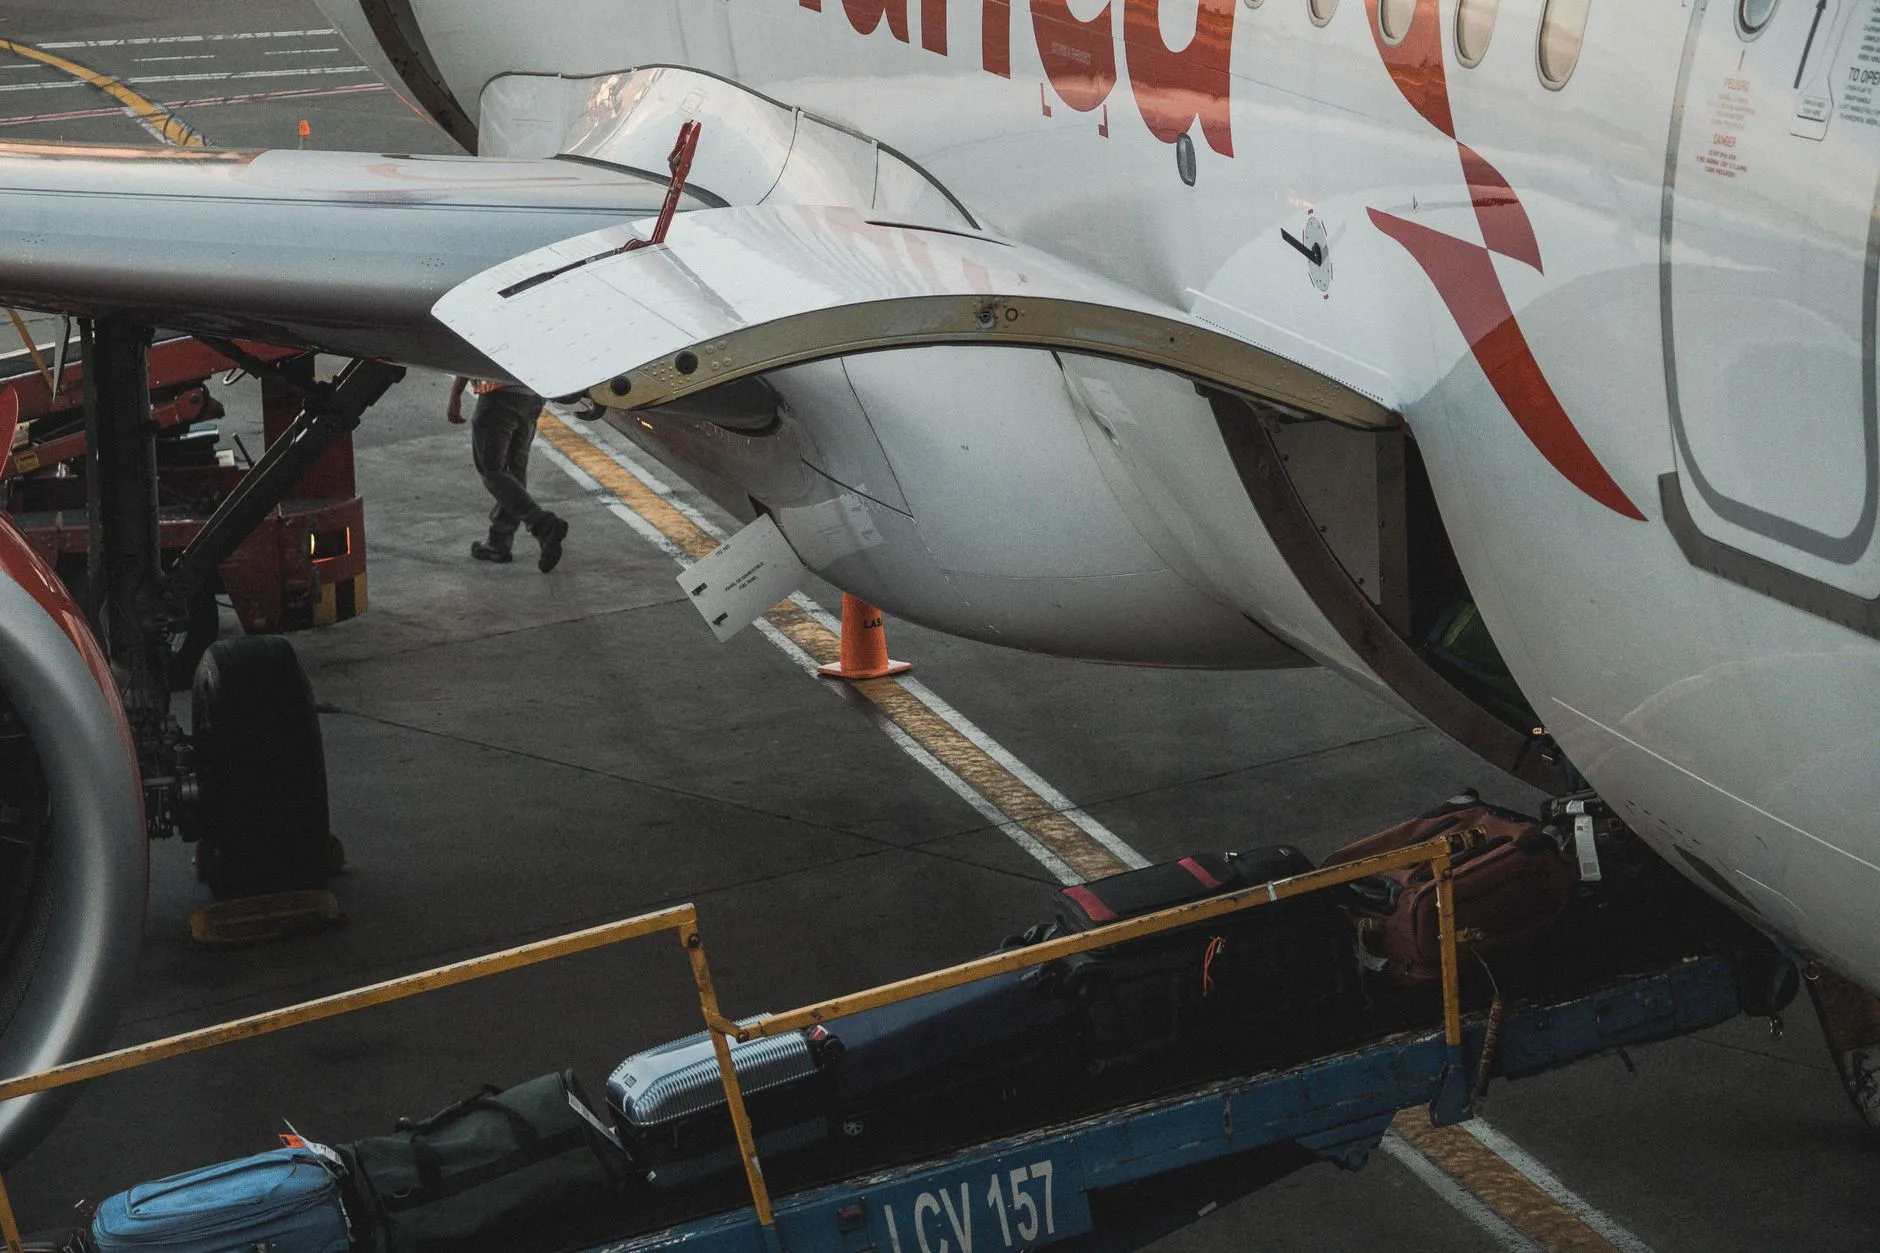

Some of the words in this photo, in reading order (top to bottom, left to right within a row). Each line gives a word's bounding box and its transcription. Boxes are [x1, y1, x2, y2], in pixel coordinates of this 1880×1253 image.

[1849, 66, 1860, 81] TO
[1861, 70, 1880, 86] OPE
[1713, 133, 1736, 148] DANGER
[987, 1160, 1055, 1247] 157
